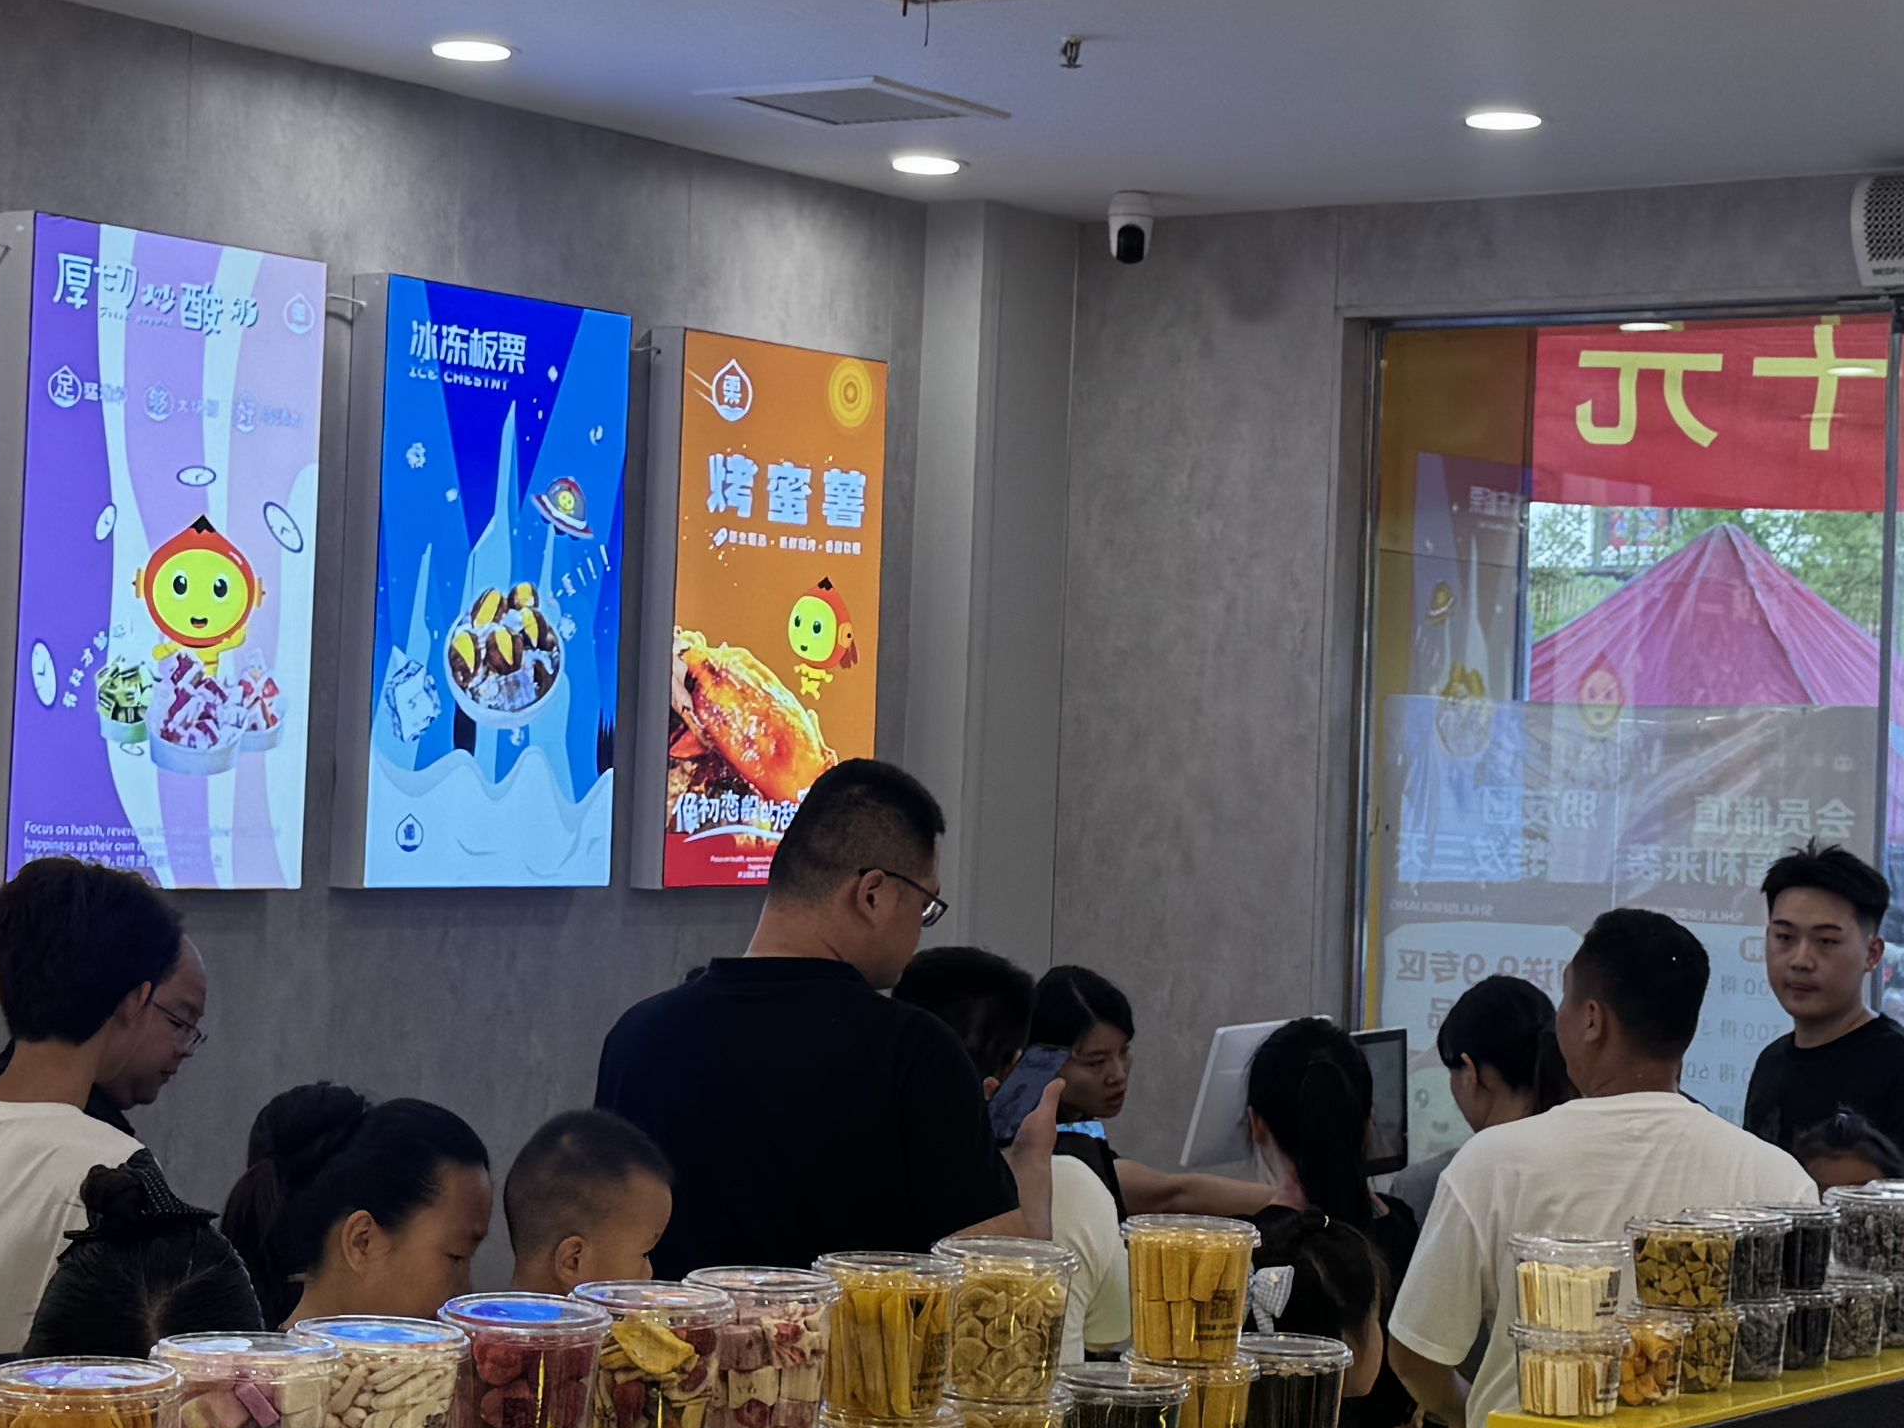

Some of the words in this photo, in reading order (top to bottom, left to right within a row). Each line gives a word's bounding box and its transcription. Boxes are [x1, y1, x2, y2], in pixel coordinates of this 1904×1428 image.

[53, 253, 260, 335] 厚切炒酸奶
[409, 320, 527, 374] 冰冻板栗
[707, 451, 868, 529] 烤蜜薯
[24, 821, 55, 834] Focus
[56, 826, 69, 835] on
[672, 787, 810, 834] 像初恋般的甜
